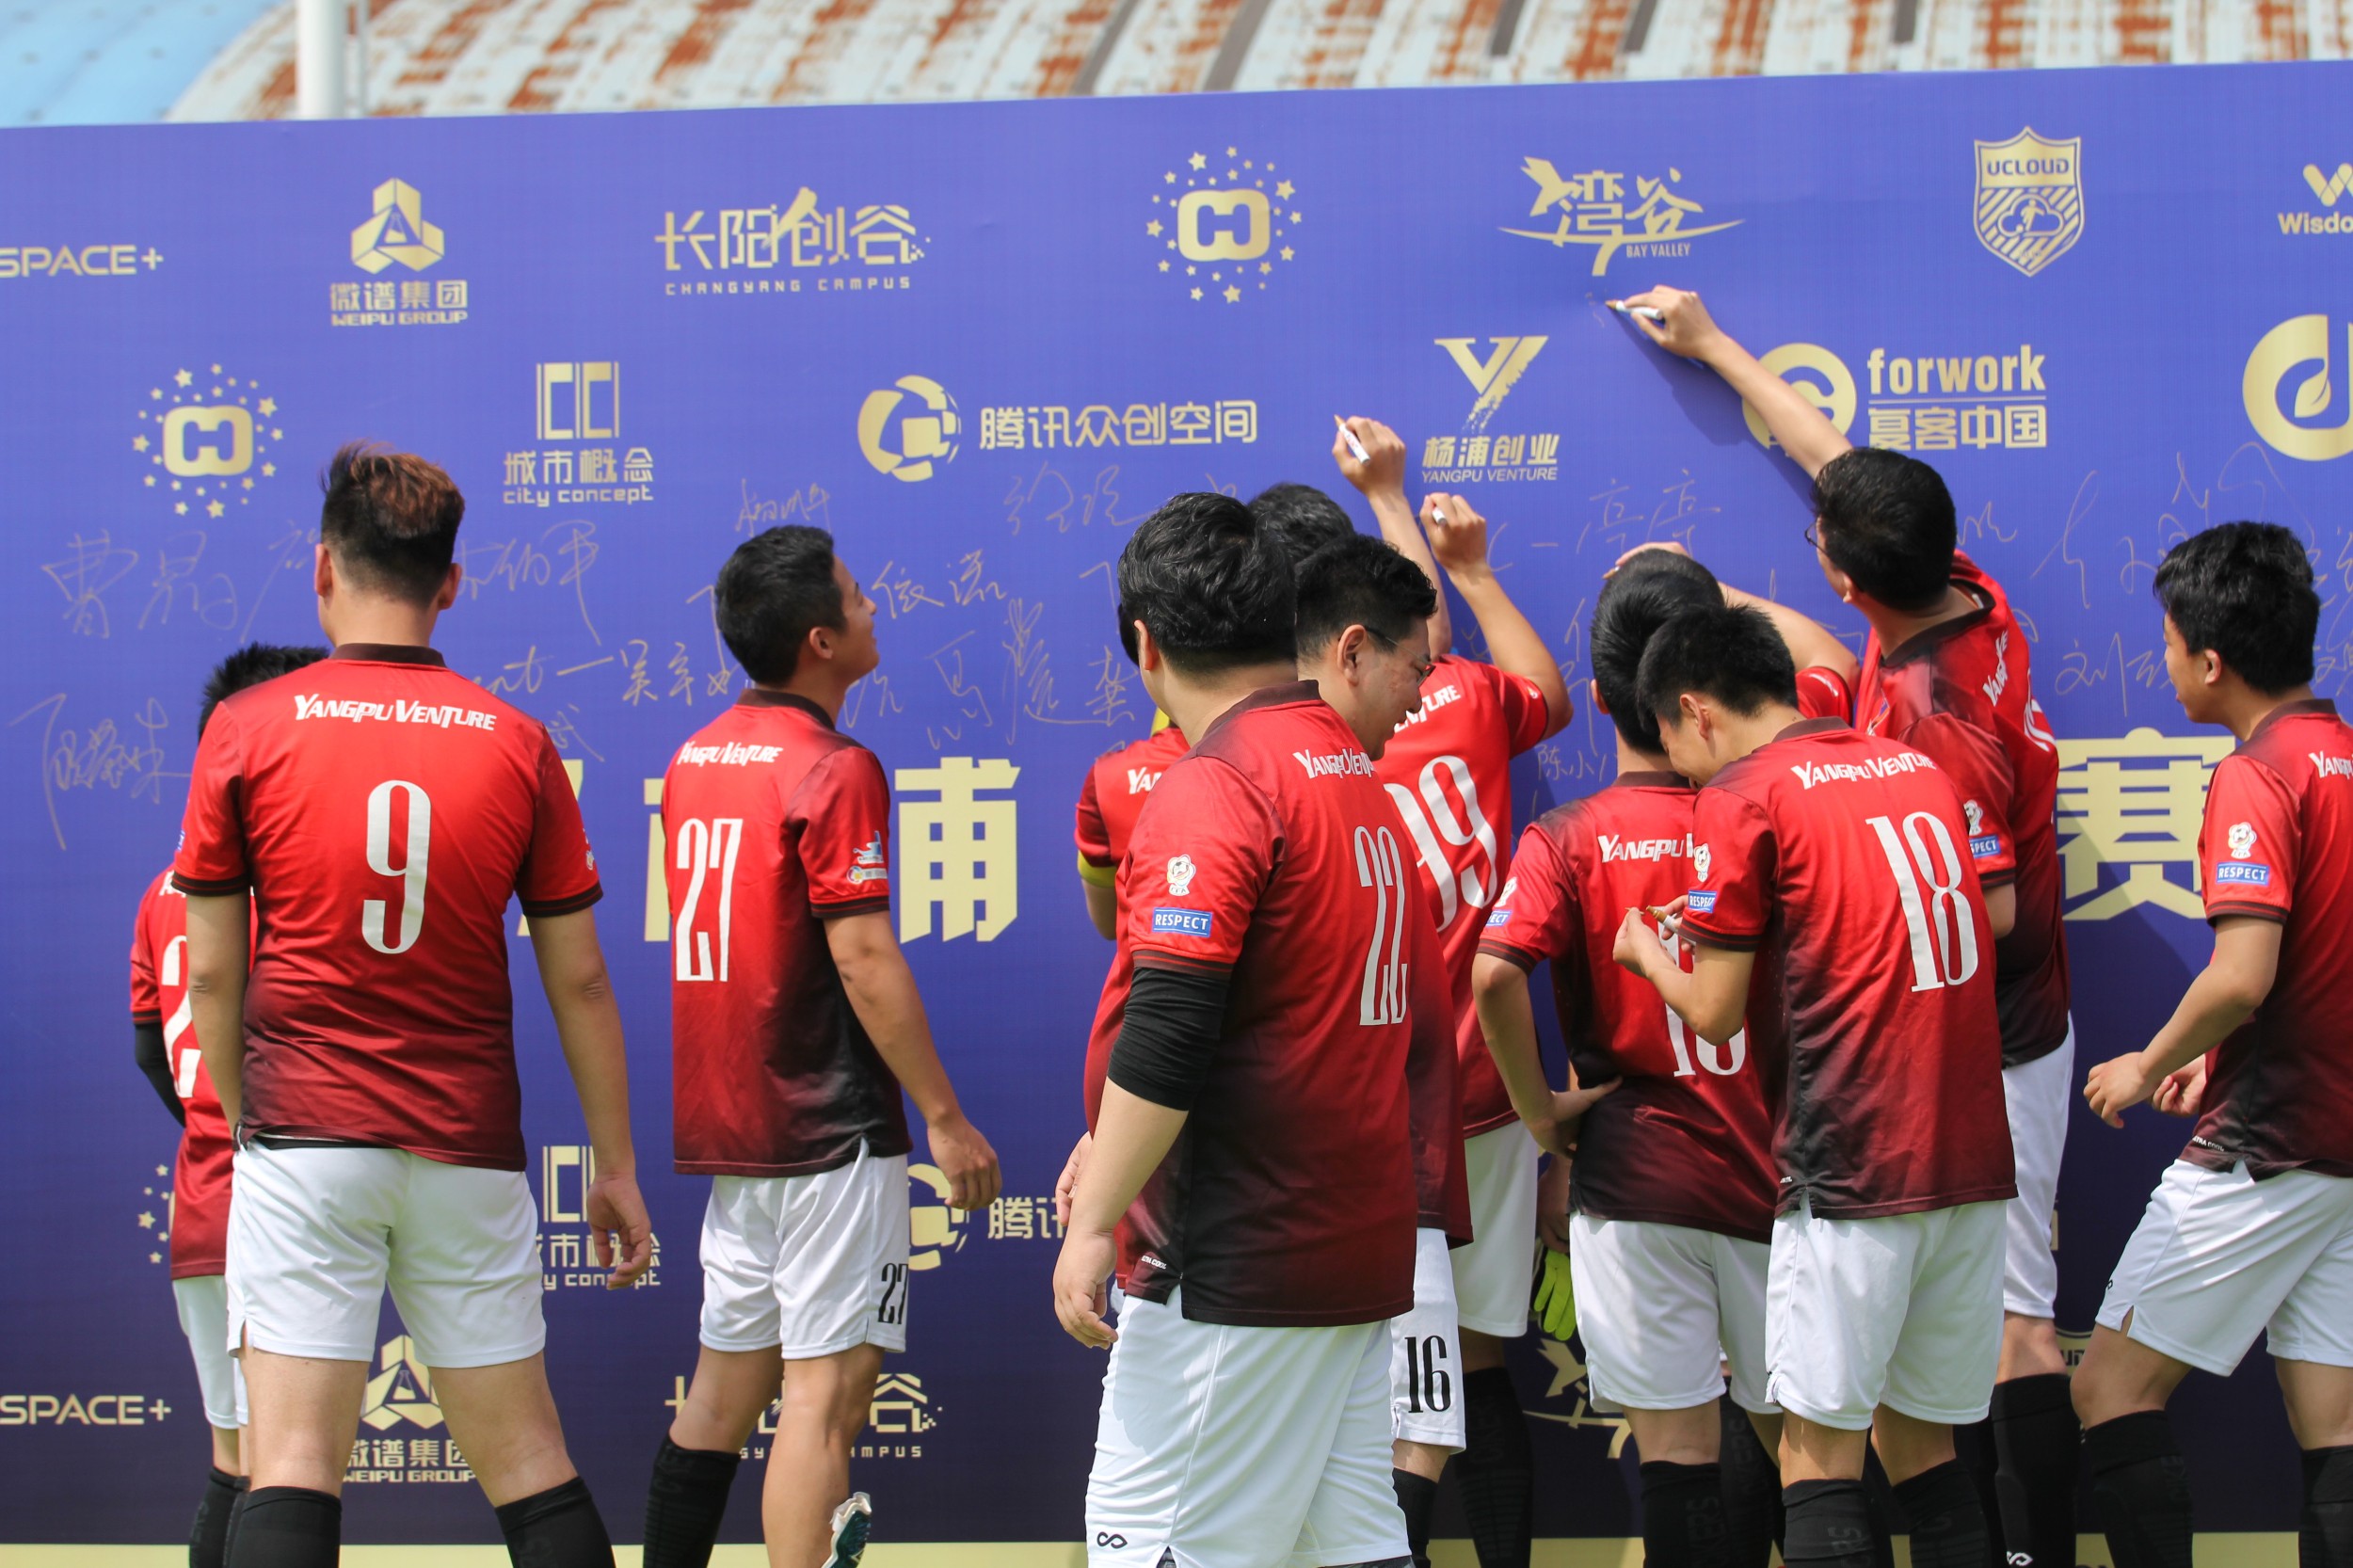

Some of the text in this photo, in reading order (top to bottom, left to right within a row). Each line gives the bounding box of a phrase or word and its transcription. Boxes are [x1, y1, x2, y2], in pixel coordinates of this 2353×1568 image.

[1987, 158, 2070, 176] UCLOUD
[1625, 243, 1691, 258] BAY VALLEY
[330, 280, 468, 312] 微谱集团
[665, 277, 910, 296] CHANGYANG CAMPUS
[331, 310, 468, 326] WEIPU GROUP
[1867, 344, 2046, 394] forwork
[980, 400, 1257, 450] 腾讯众创空间
[504, 447, 654, 486] 城市概念
[1422, 434, 1561, 468] 杨浦创业
[1422, 467, 1559, 483] YANGPU VENTURE
[504, 485, 654, 507] city concept
[294, 694, 497, 731] YANGPU VENTURE
[1790, 760, 1872, 790] YANGPU
[1597, 834, 1684, 863] YANGPU
[361, 779, 431, 954] 9
[2217, 866, 2266, 881] RESPECT
[675, 818, 743, 982] 27
[1865, 810, 1978, 993] 18
[1155, 914, 1209, 930] RESPECT
[1353, 825, 1408, 1026] 22
[877, 1262, 909, 1325] 27
[1406, 1336, 1451, 1414] 16
[407, 1470, 476, 1482] GROUP
